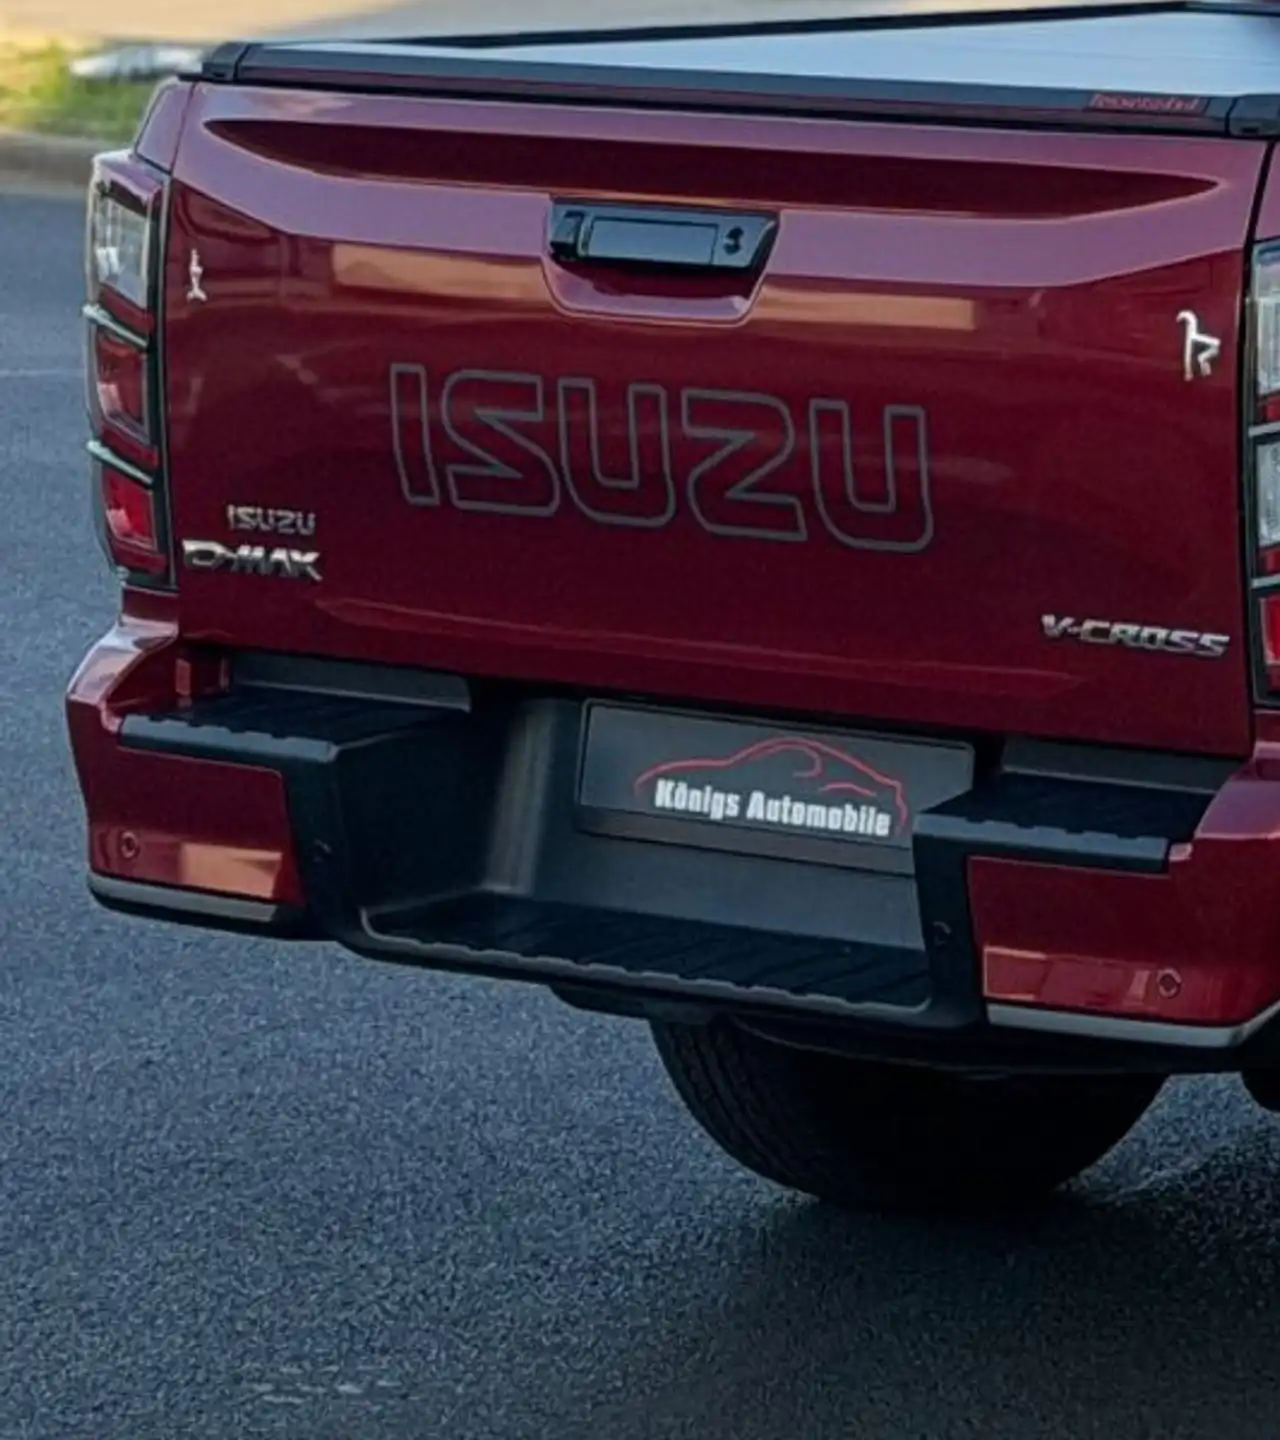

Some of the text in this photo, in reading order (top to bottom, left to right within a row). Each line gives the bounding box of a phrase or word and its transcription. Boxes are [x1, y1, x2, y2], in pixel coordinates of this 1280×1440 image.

[390, 363, 934, 553] ISUZU
[227, 504, 316, 535] ISUZU
[182, 539, 323, 581] D-MAX
[1041, 613, 1230, 657] V-CROSS
[654, 777, 893, 837] Königs Automobile
